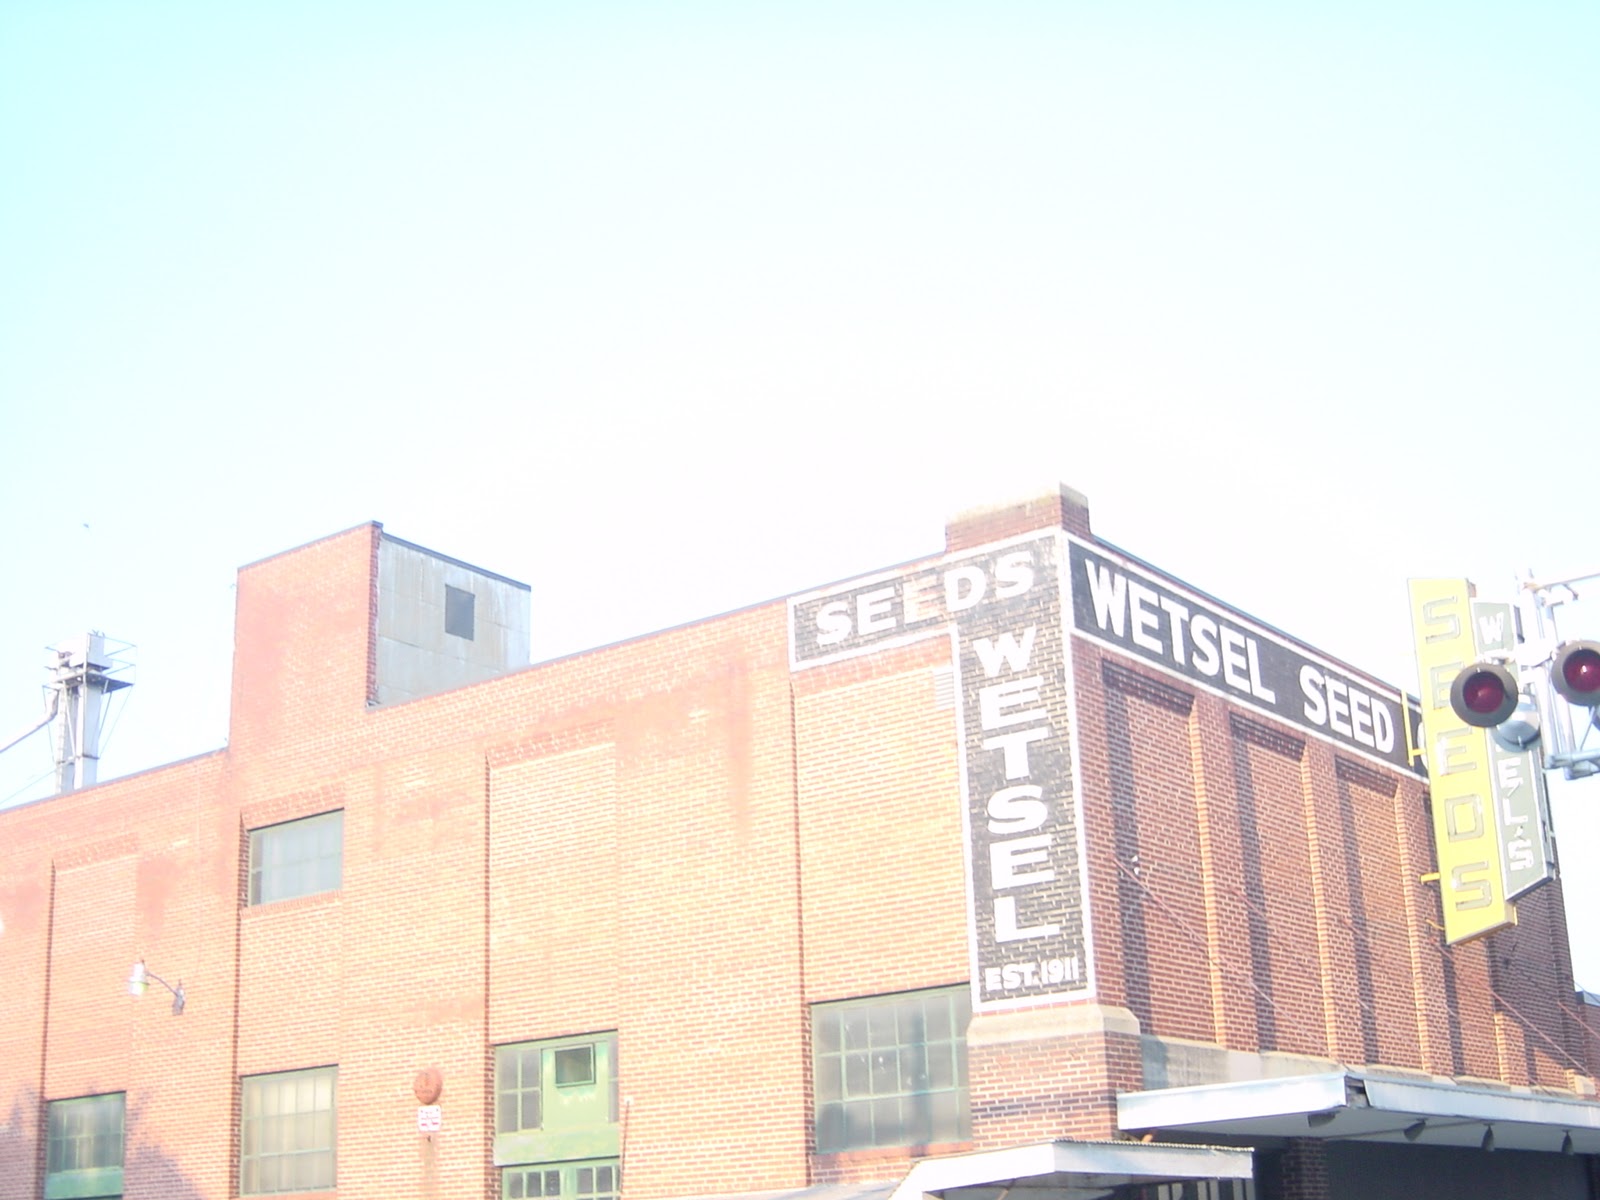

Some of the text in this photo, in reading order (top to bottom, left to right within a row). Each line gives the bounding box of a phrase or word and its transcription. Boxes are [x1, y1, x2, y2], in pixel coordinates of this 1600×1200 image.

[816, 550, 1036, 646] SEEDS
[1084, 558, 1276, 705] WETSEL
[1299, 664, 1394, 753] SEED
[972, 625, 1060, 944] WETSEL
[1479, 611, 1534, 872] WEL'S
